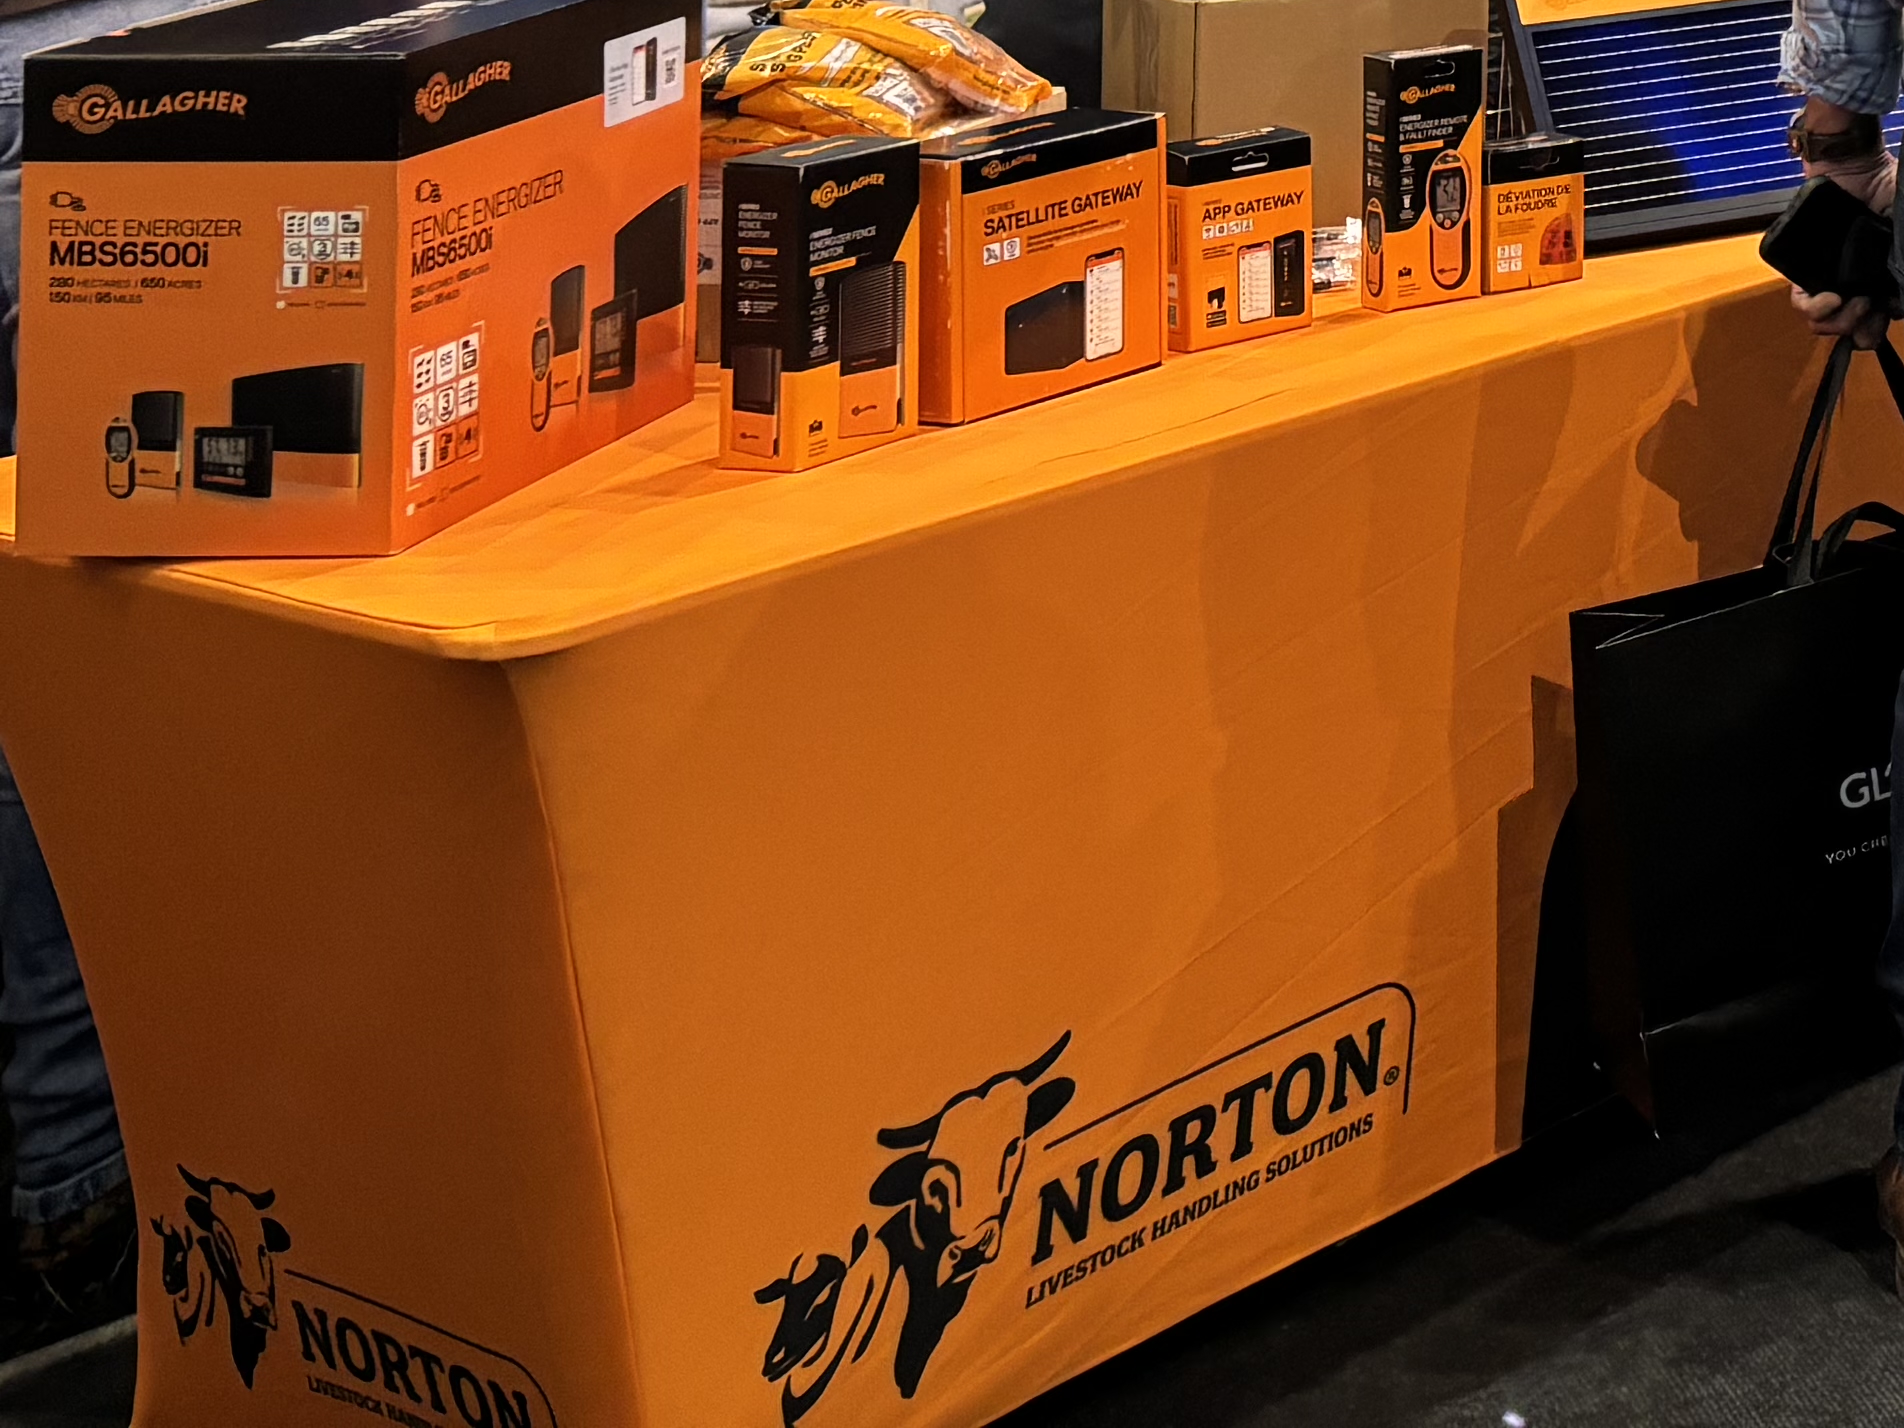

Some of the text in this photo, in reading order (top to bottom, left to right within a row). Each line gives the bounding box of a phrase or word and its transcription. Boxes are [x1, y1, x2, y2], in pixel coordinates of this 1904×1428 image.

[81, 89, 248, 122] GALLAGHER
[429, 60, 512, 110] GALLAGHER
[411, 169, 564, 249] FENCE ENERGIZER
[821, 173, 885, 202] GALLAGHER
[983, 202, 1069, 238] SATELLITE
[1071, 180, 1143, 215] GATEWAY
[1202, 190, 1305, 223] APP GATEWAY
[49, 219, 242, 238] FENCE ENERGIZER
[411, 226, 494, 278] MBS6500i
[49, 241, 209, 268] MBS6500i
[1839, 761, 1893, 809] GL
[1031, 1017, 1386, 1267] NORTON
[1025, 1112, 1375, 1310] LIVESTOCK HANDLING SOLUTIONS
[291, 1299, 533, 1428] NORTON
